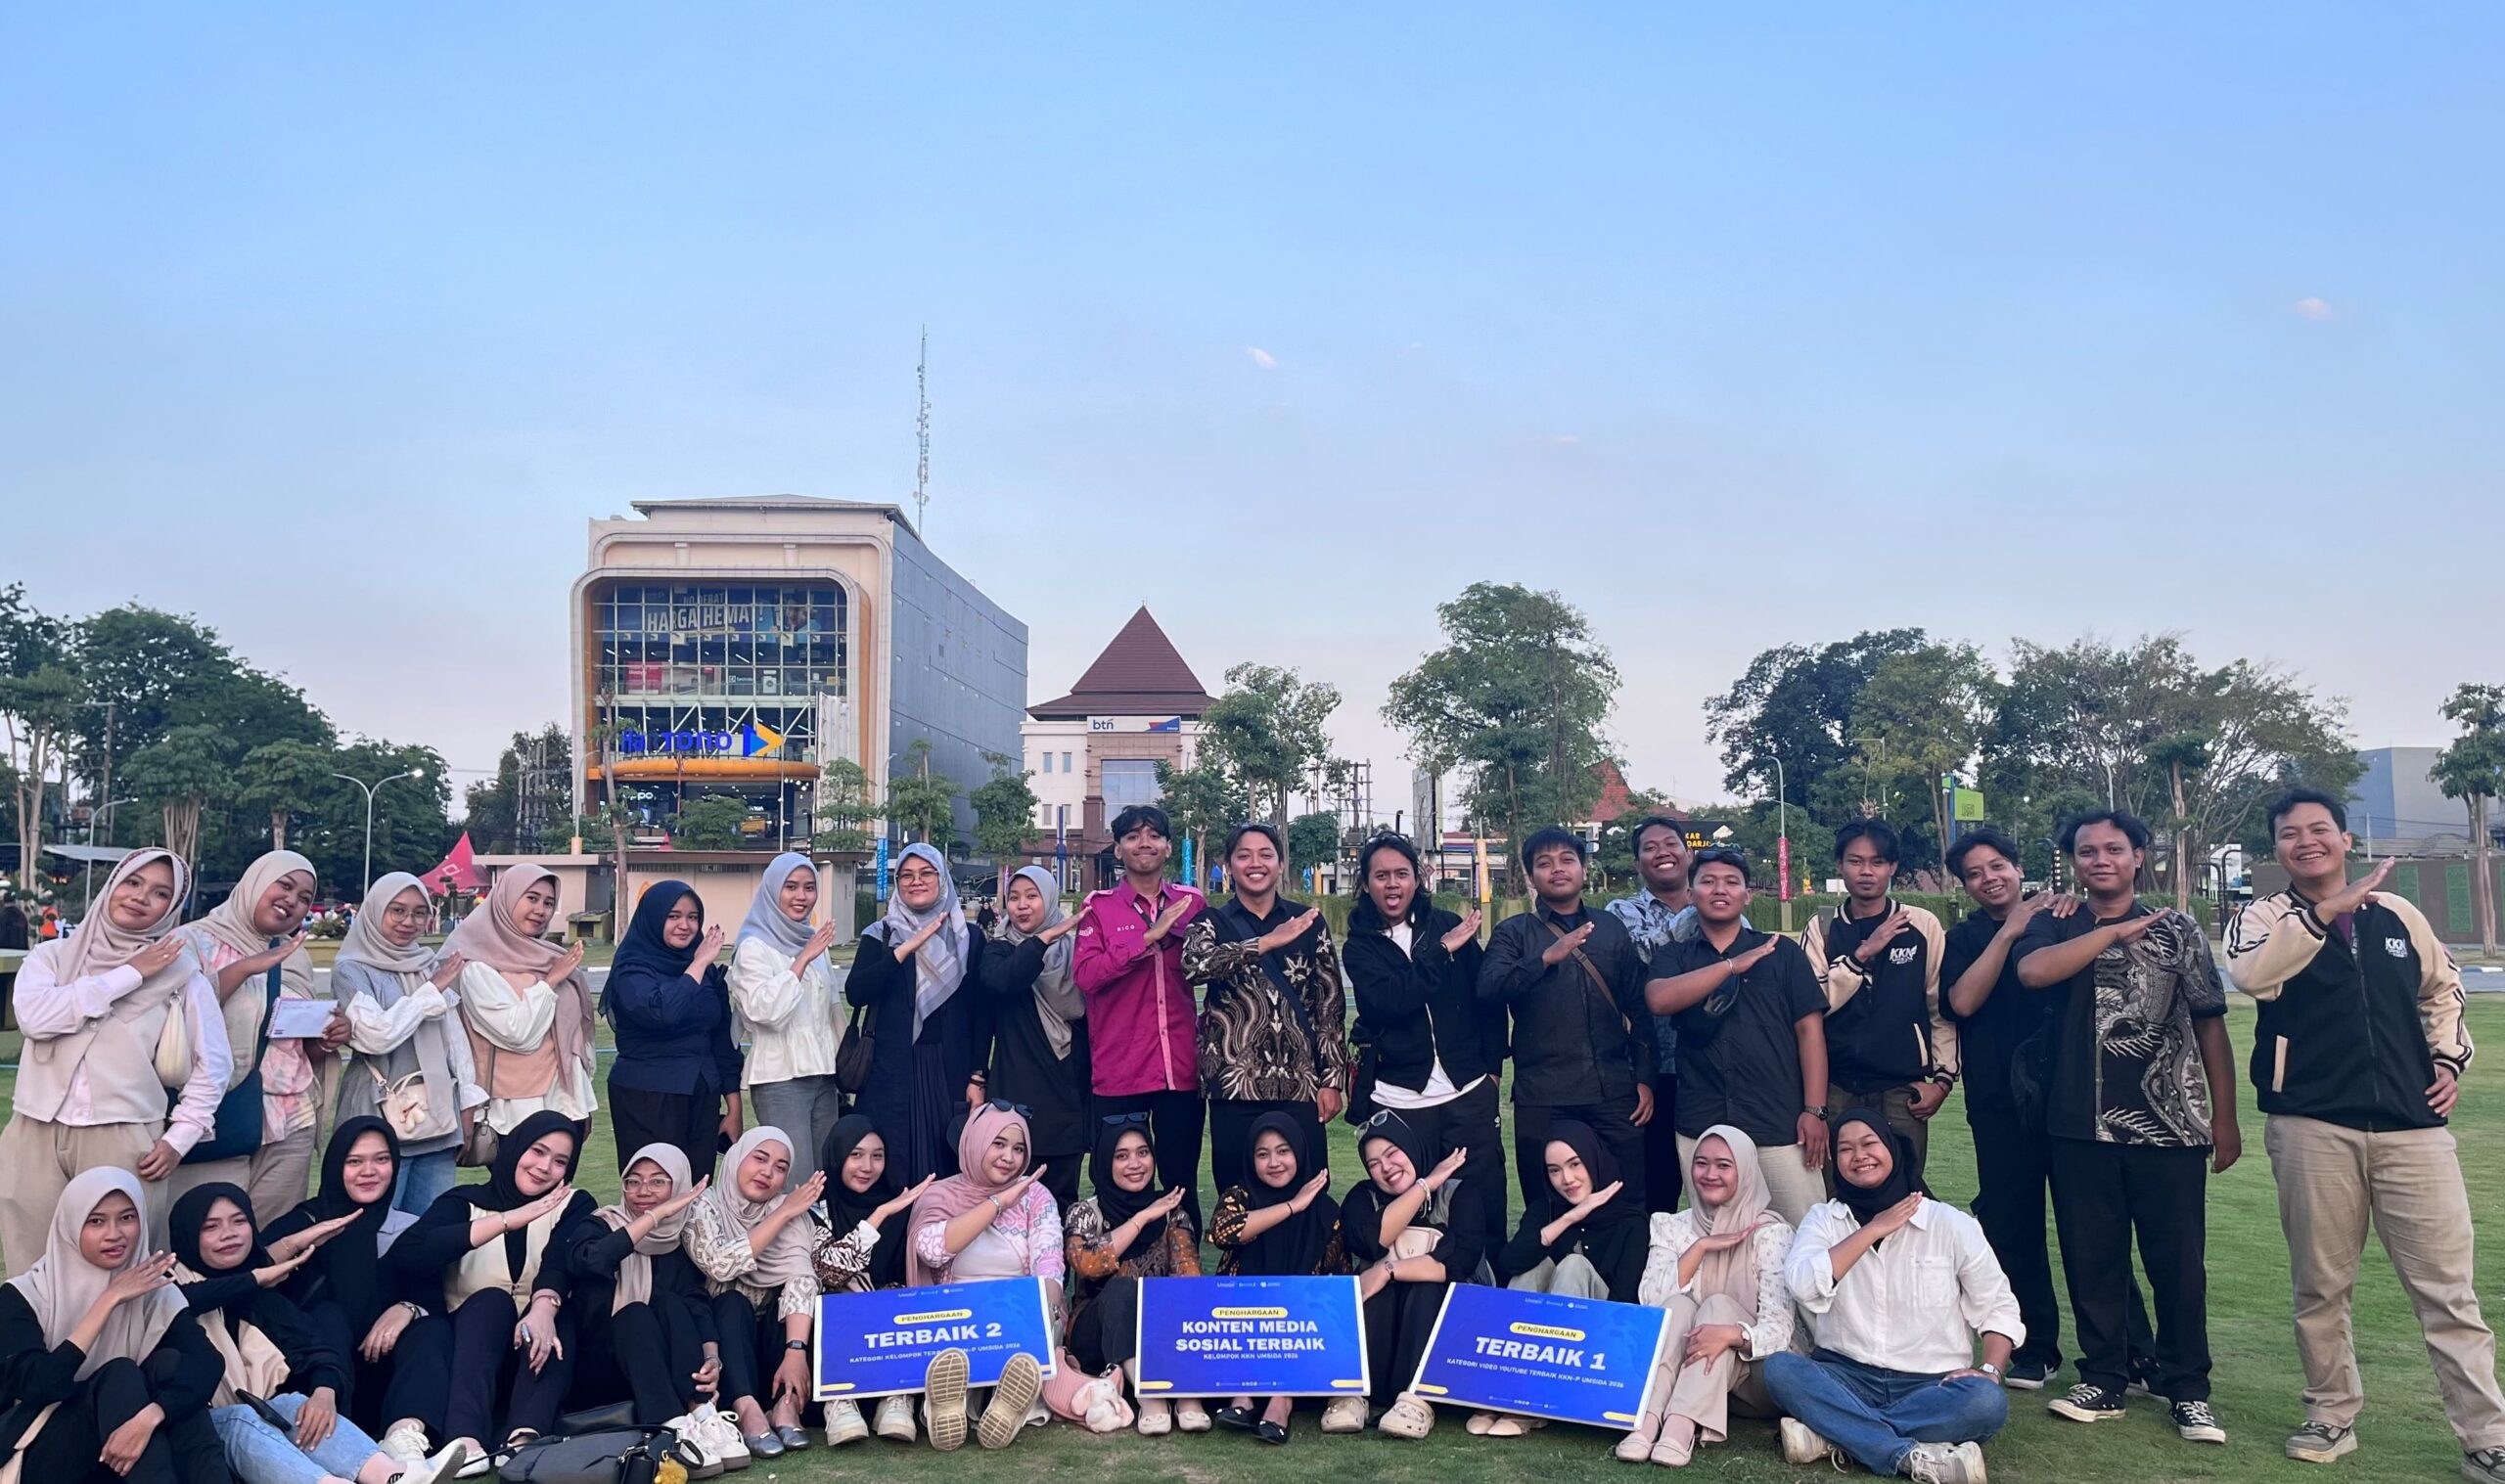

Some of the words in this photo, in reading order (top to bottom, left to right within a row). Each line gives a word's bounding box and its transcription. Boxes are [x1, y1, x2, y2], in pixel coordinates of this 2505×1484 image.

[1092, 718, 1115, 731] btn
[1182, 1321, 1253, 1333] KONTEN
[1259, 1321, 1318, 1332] MEDIA
[1517, 1325, 1577, 1338] PENGHARGAAN
[864, 1324, 979, 1349] TERBAIK
[985, 1322, 1002, 1337] 2
[1175, 1338, 1243, 1351] SOSIAL
[1247, 1337, 1325, 1350] TERBAIK
[1476, 1336, 1584, 1368] TERBAIK
[1589, 1352, 1607, 1371] 1
[1446, 1358, 1479, 1368] KATEGORI
[1529, 1369, 1557, 1379] TERBAIK
